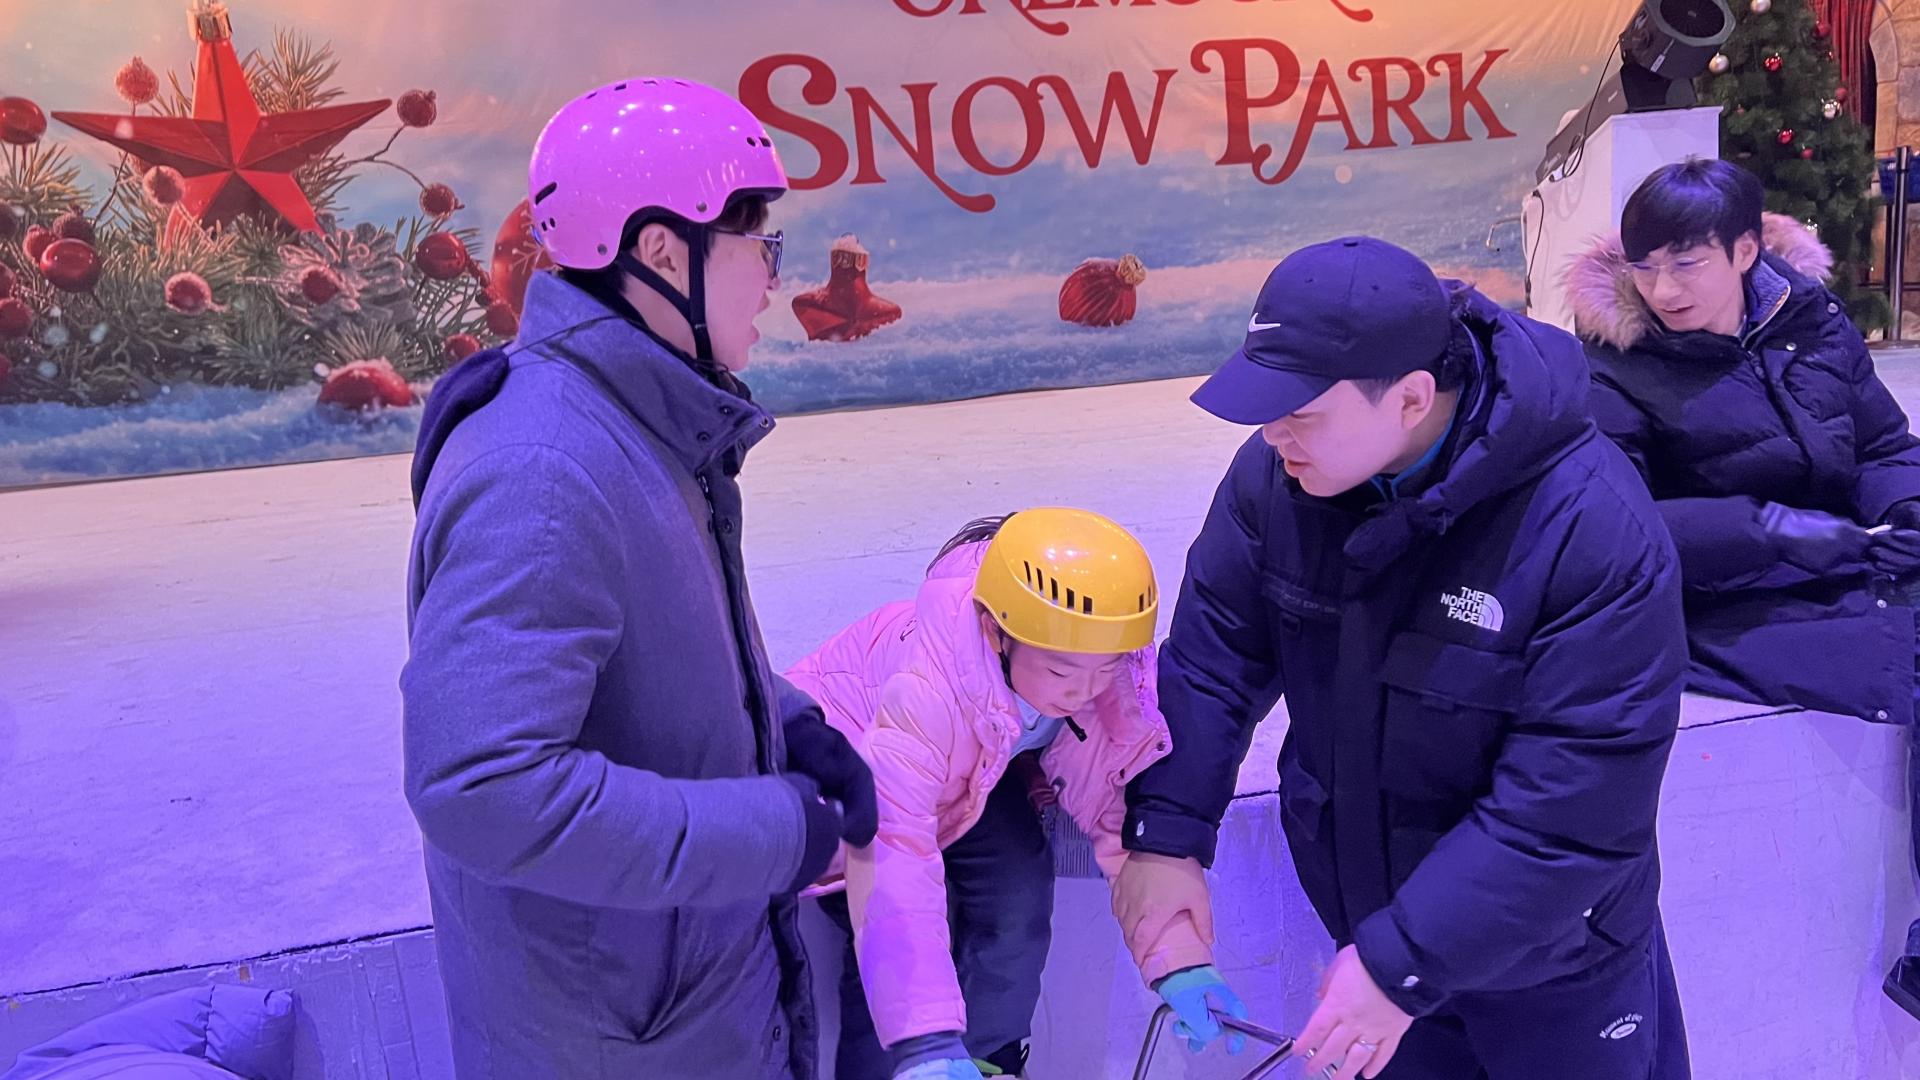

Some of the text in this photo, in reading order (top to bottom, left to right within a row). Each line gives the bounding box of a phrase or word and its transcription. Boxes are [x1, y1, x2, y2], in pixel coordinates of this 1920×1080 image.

[737, 37, 1517, 213] SNOW PARK
[1440, 592, 1482, 614] NORTH
[1461, 586, 1485, 603] THE
[1447, 606, 1480, 625] FACE
